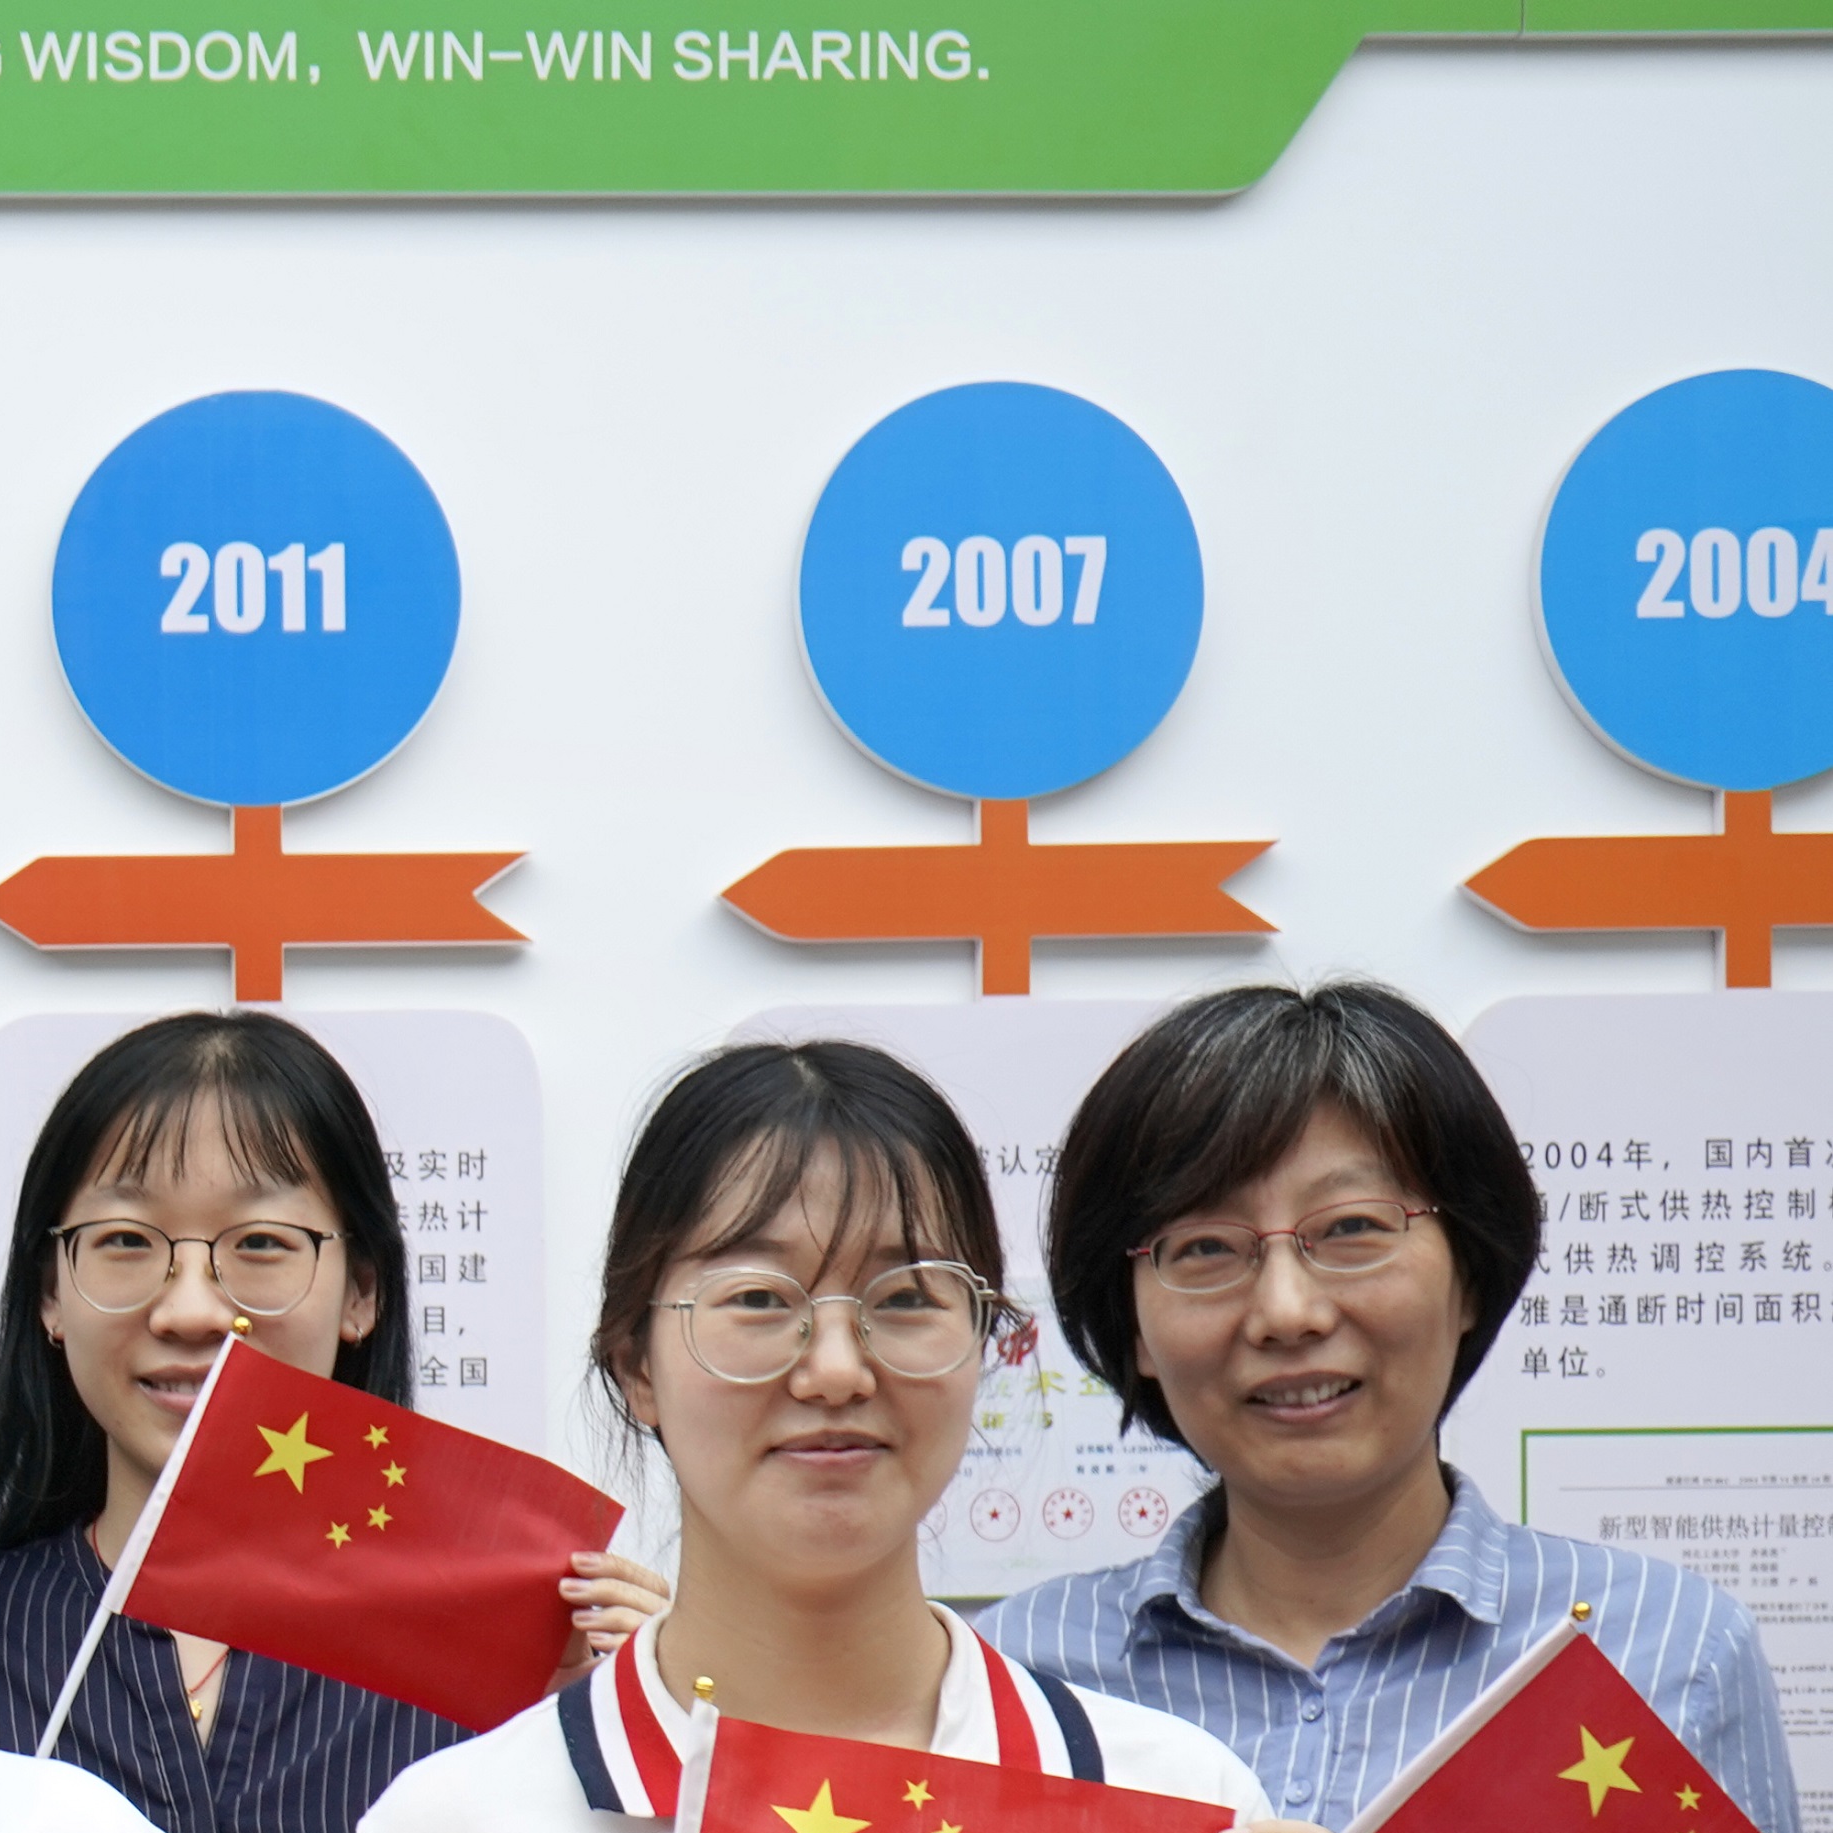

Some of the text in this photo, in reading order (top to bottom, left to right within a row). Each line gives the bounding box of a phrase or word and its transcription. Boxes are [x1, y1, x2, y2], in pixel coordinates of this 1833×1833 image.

[19, 30, 320, 85] WISDOM,
[672, 29, 989, 81] SHARING.
[159, 541, 348, 635] 2011
[900, 534, 1108, 628] 2007
[1635, 526, 1833, 619] 2004
[1518, 1136, 1833, 1172] 2004年，国内首
[1536, 1187, 1833, 1224] /断式供热控制
[1519, 1291, 1833, 1327] 雅是通断时间面积
